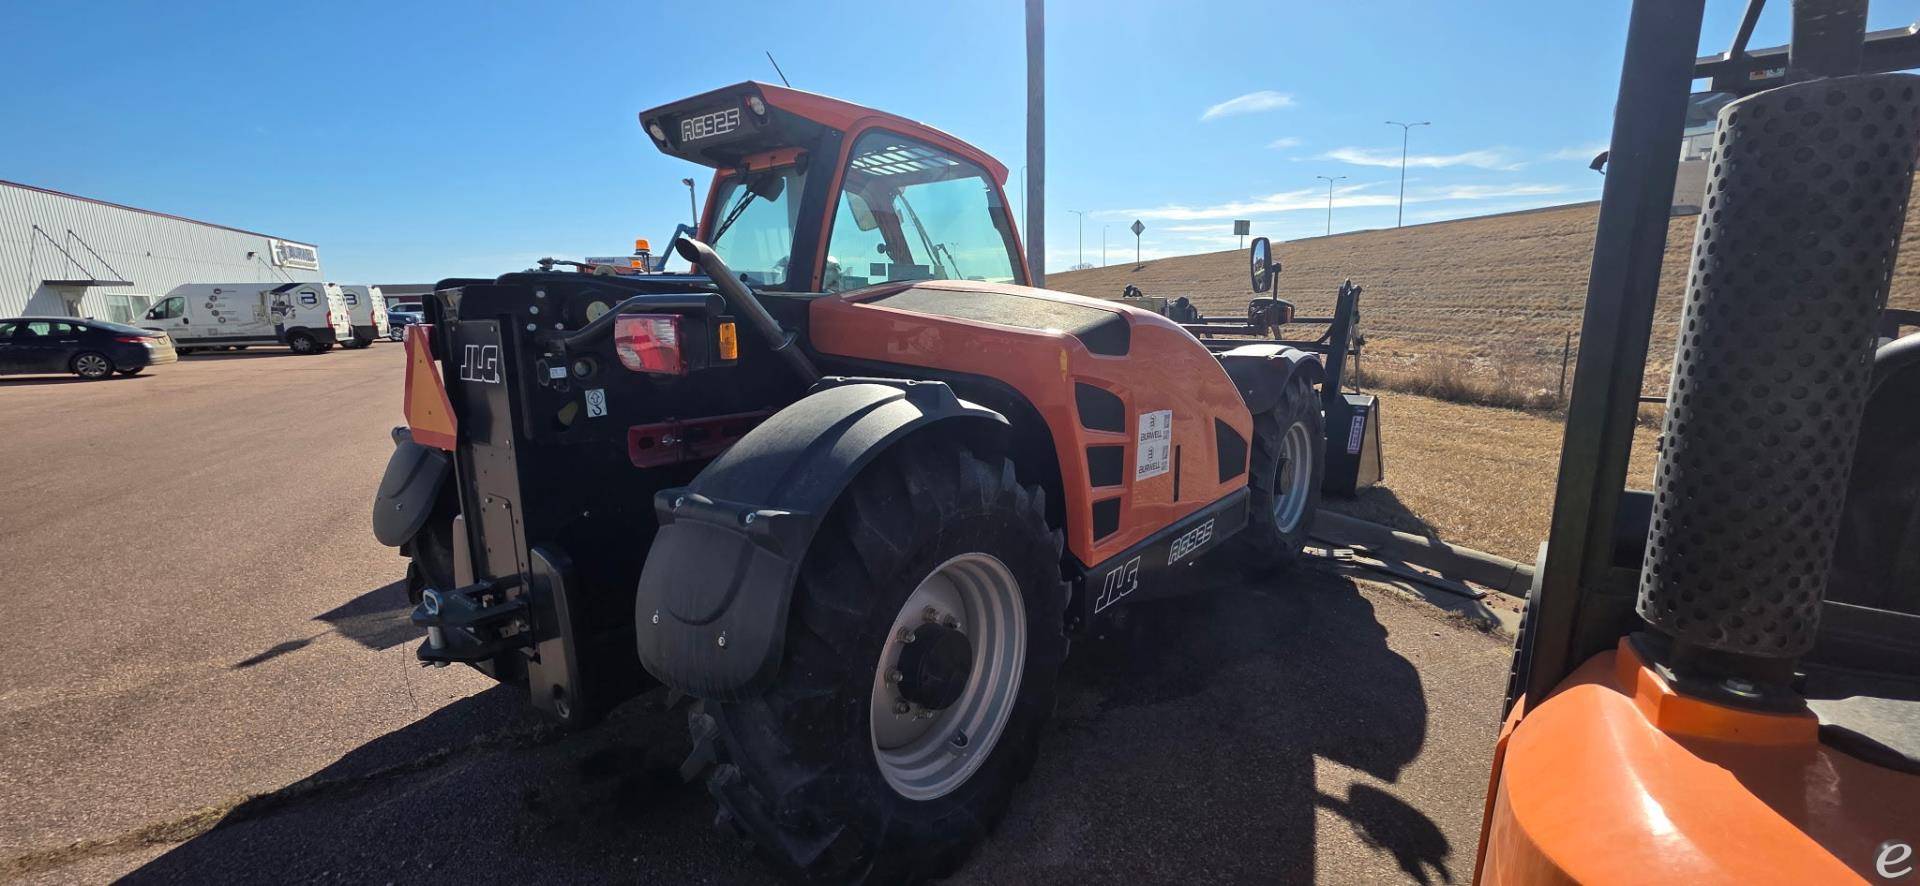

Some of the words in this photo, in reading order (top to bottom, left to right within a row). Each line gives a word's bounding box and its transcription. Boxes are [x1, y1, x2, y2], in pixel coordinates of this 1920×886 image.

[681, 107, 741, 142] AG925
[460, 344, 499, 383] JLG
[1140, 429, 1163, 442] BURWELL
[1138, 460, 1161, 474] BURWELL
[1167, 518, 1215, 566] AG925
[1094, 555, 1141, 614] JLG
